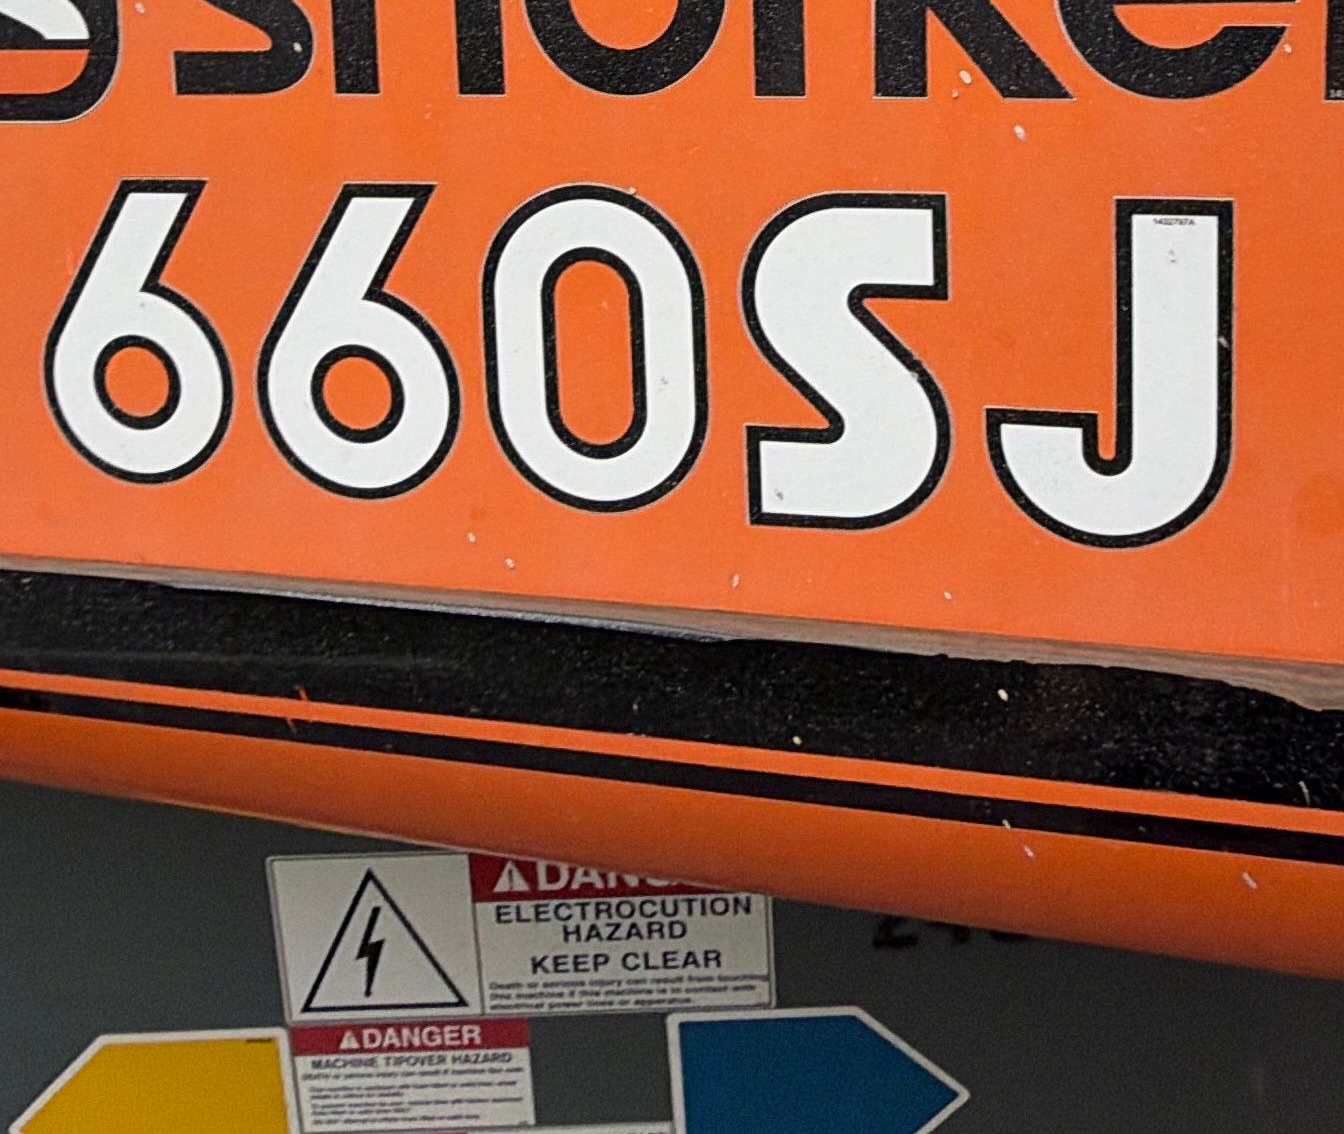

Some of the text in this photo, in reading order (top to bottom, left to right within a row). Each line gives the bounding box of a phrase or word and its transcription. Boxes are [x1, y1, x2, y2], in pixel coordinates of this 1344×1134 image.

[45, 179, 1233, 548] 660SJ
[494, 895, 752, 924] ELECTROCUTION
[562, 919, 688, 943] HAZARD
[530, 949, 722, 975] KEEP CLEAR
[362, 1024, 482, 1049] DANGER
[451, 1051, 513, 1064] HAZARD
